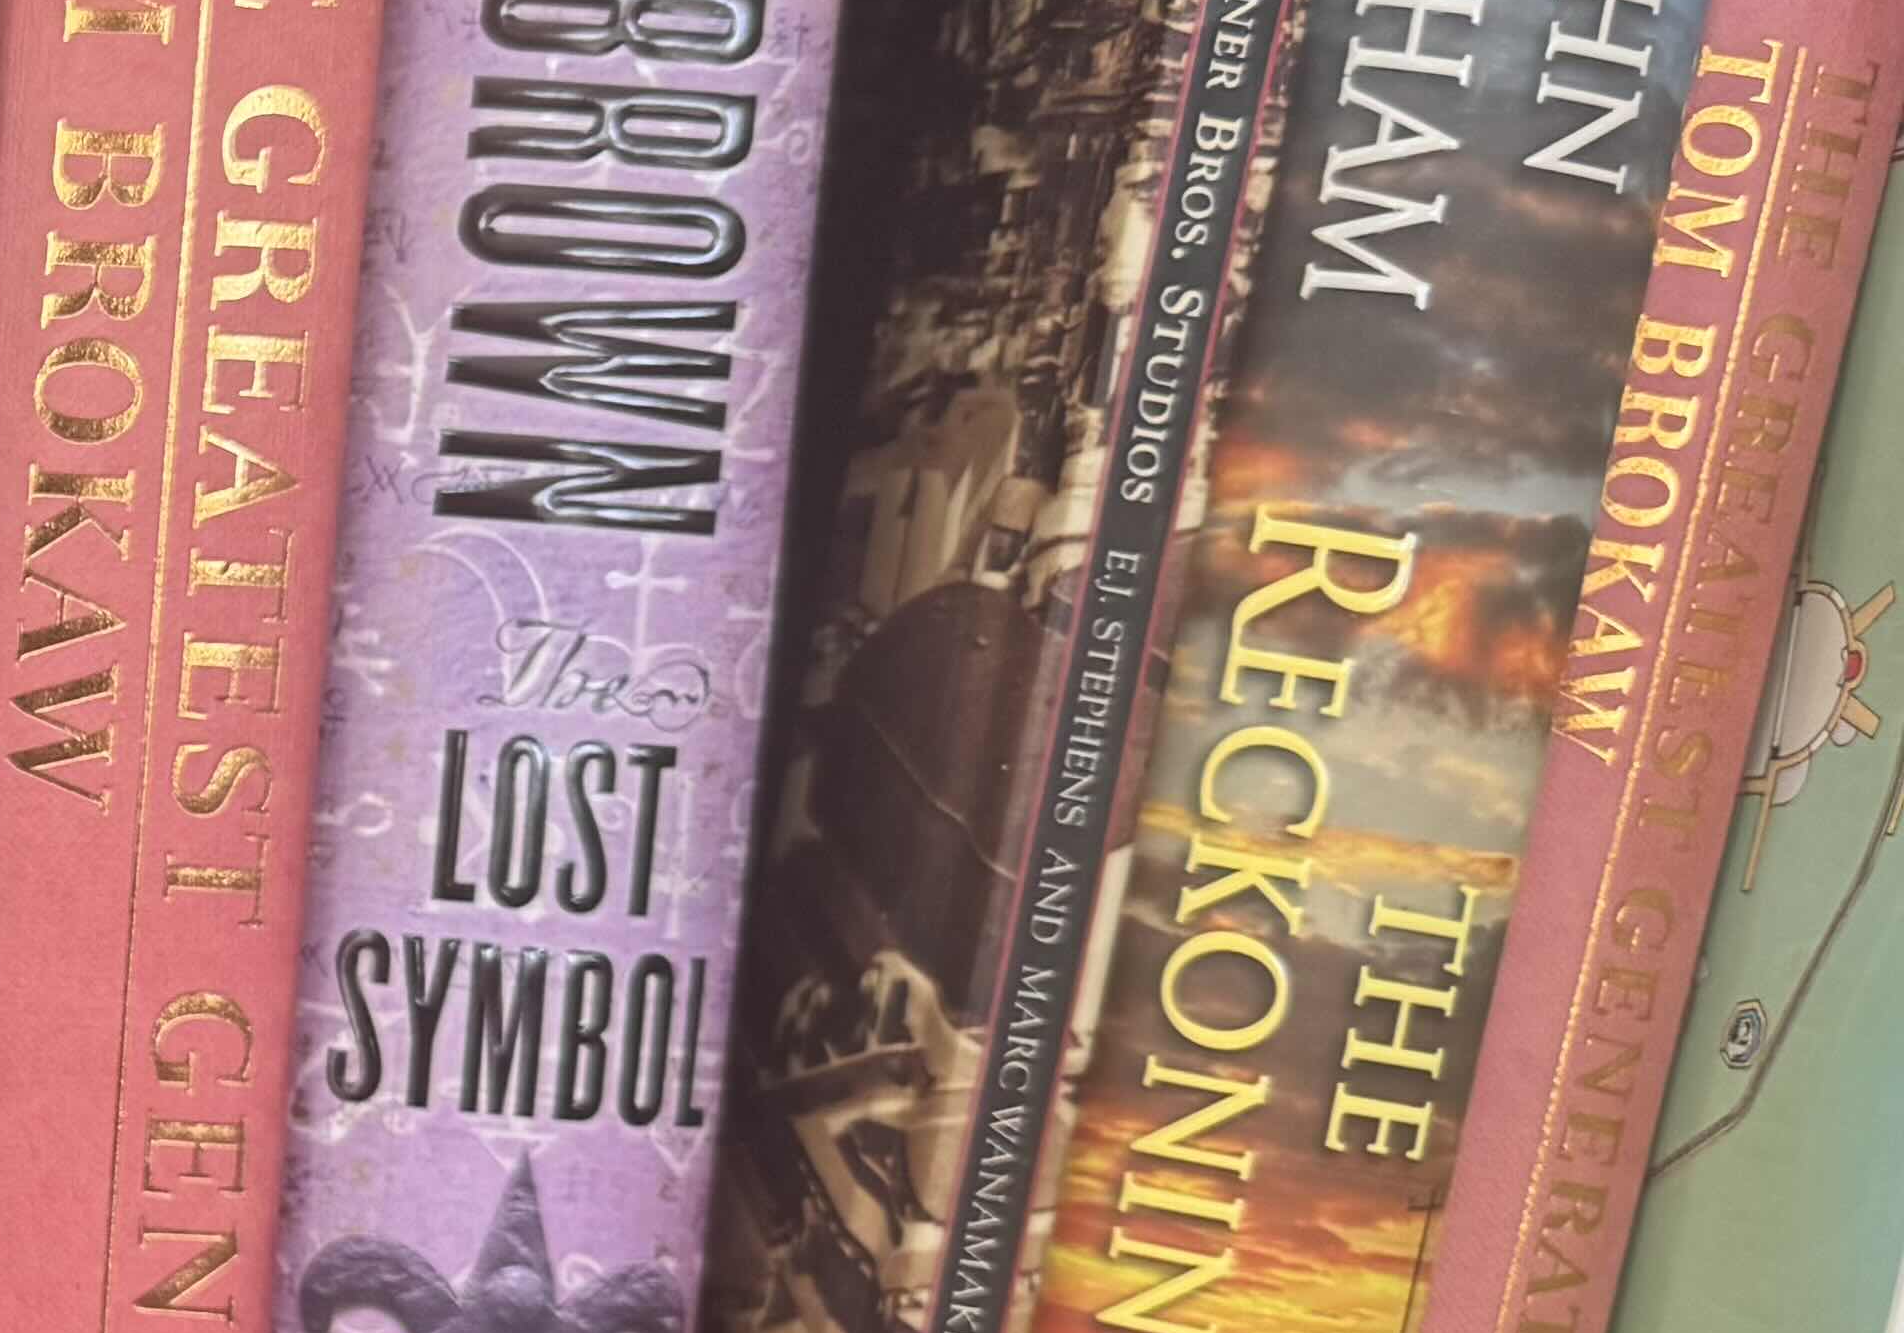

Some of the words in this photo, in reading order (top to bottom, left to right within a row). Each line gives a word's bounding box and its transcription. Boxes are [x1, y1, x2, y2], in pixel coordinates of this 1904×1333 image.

[1170, 112, 1243, 260] BROS.
[1652, 37, 1784, 279] TOM
[1777, 59, 1880, 272] THE
[4, 116, 167, 818] BROKAW
[1119, 283, 1204, 506] STUDIOS
[159, 83, 328, 930] GREATEST
[1093, 549, 1141, 604] E.J.
[1551, 313, 1718, 768] BROKAW
[1638, 312, 1816, 855] GREATEST
[477, 618, 711, 731] The
[1054, 617, 1125, 828] STEPHENS
[432, 729, 677, 916] LOST
[1029, 846, 1081, 945] AND
[326, 929, 707, 1127] SYMBOL
[997, 964, 1058, 1095] MARC
[1325, 883, 1482, 1163] THE
